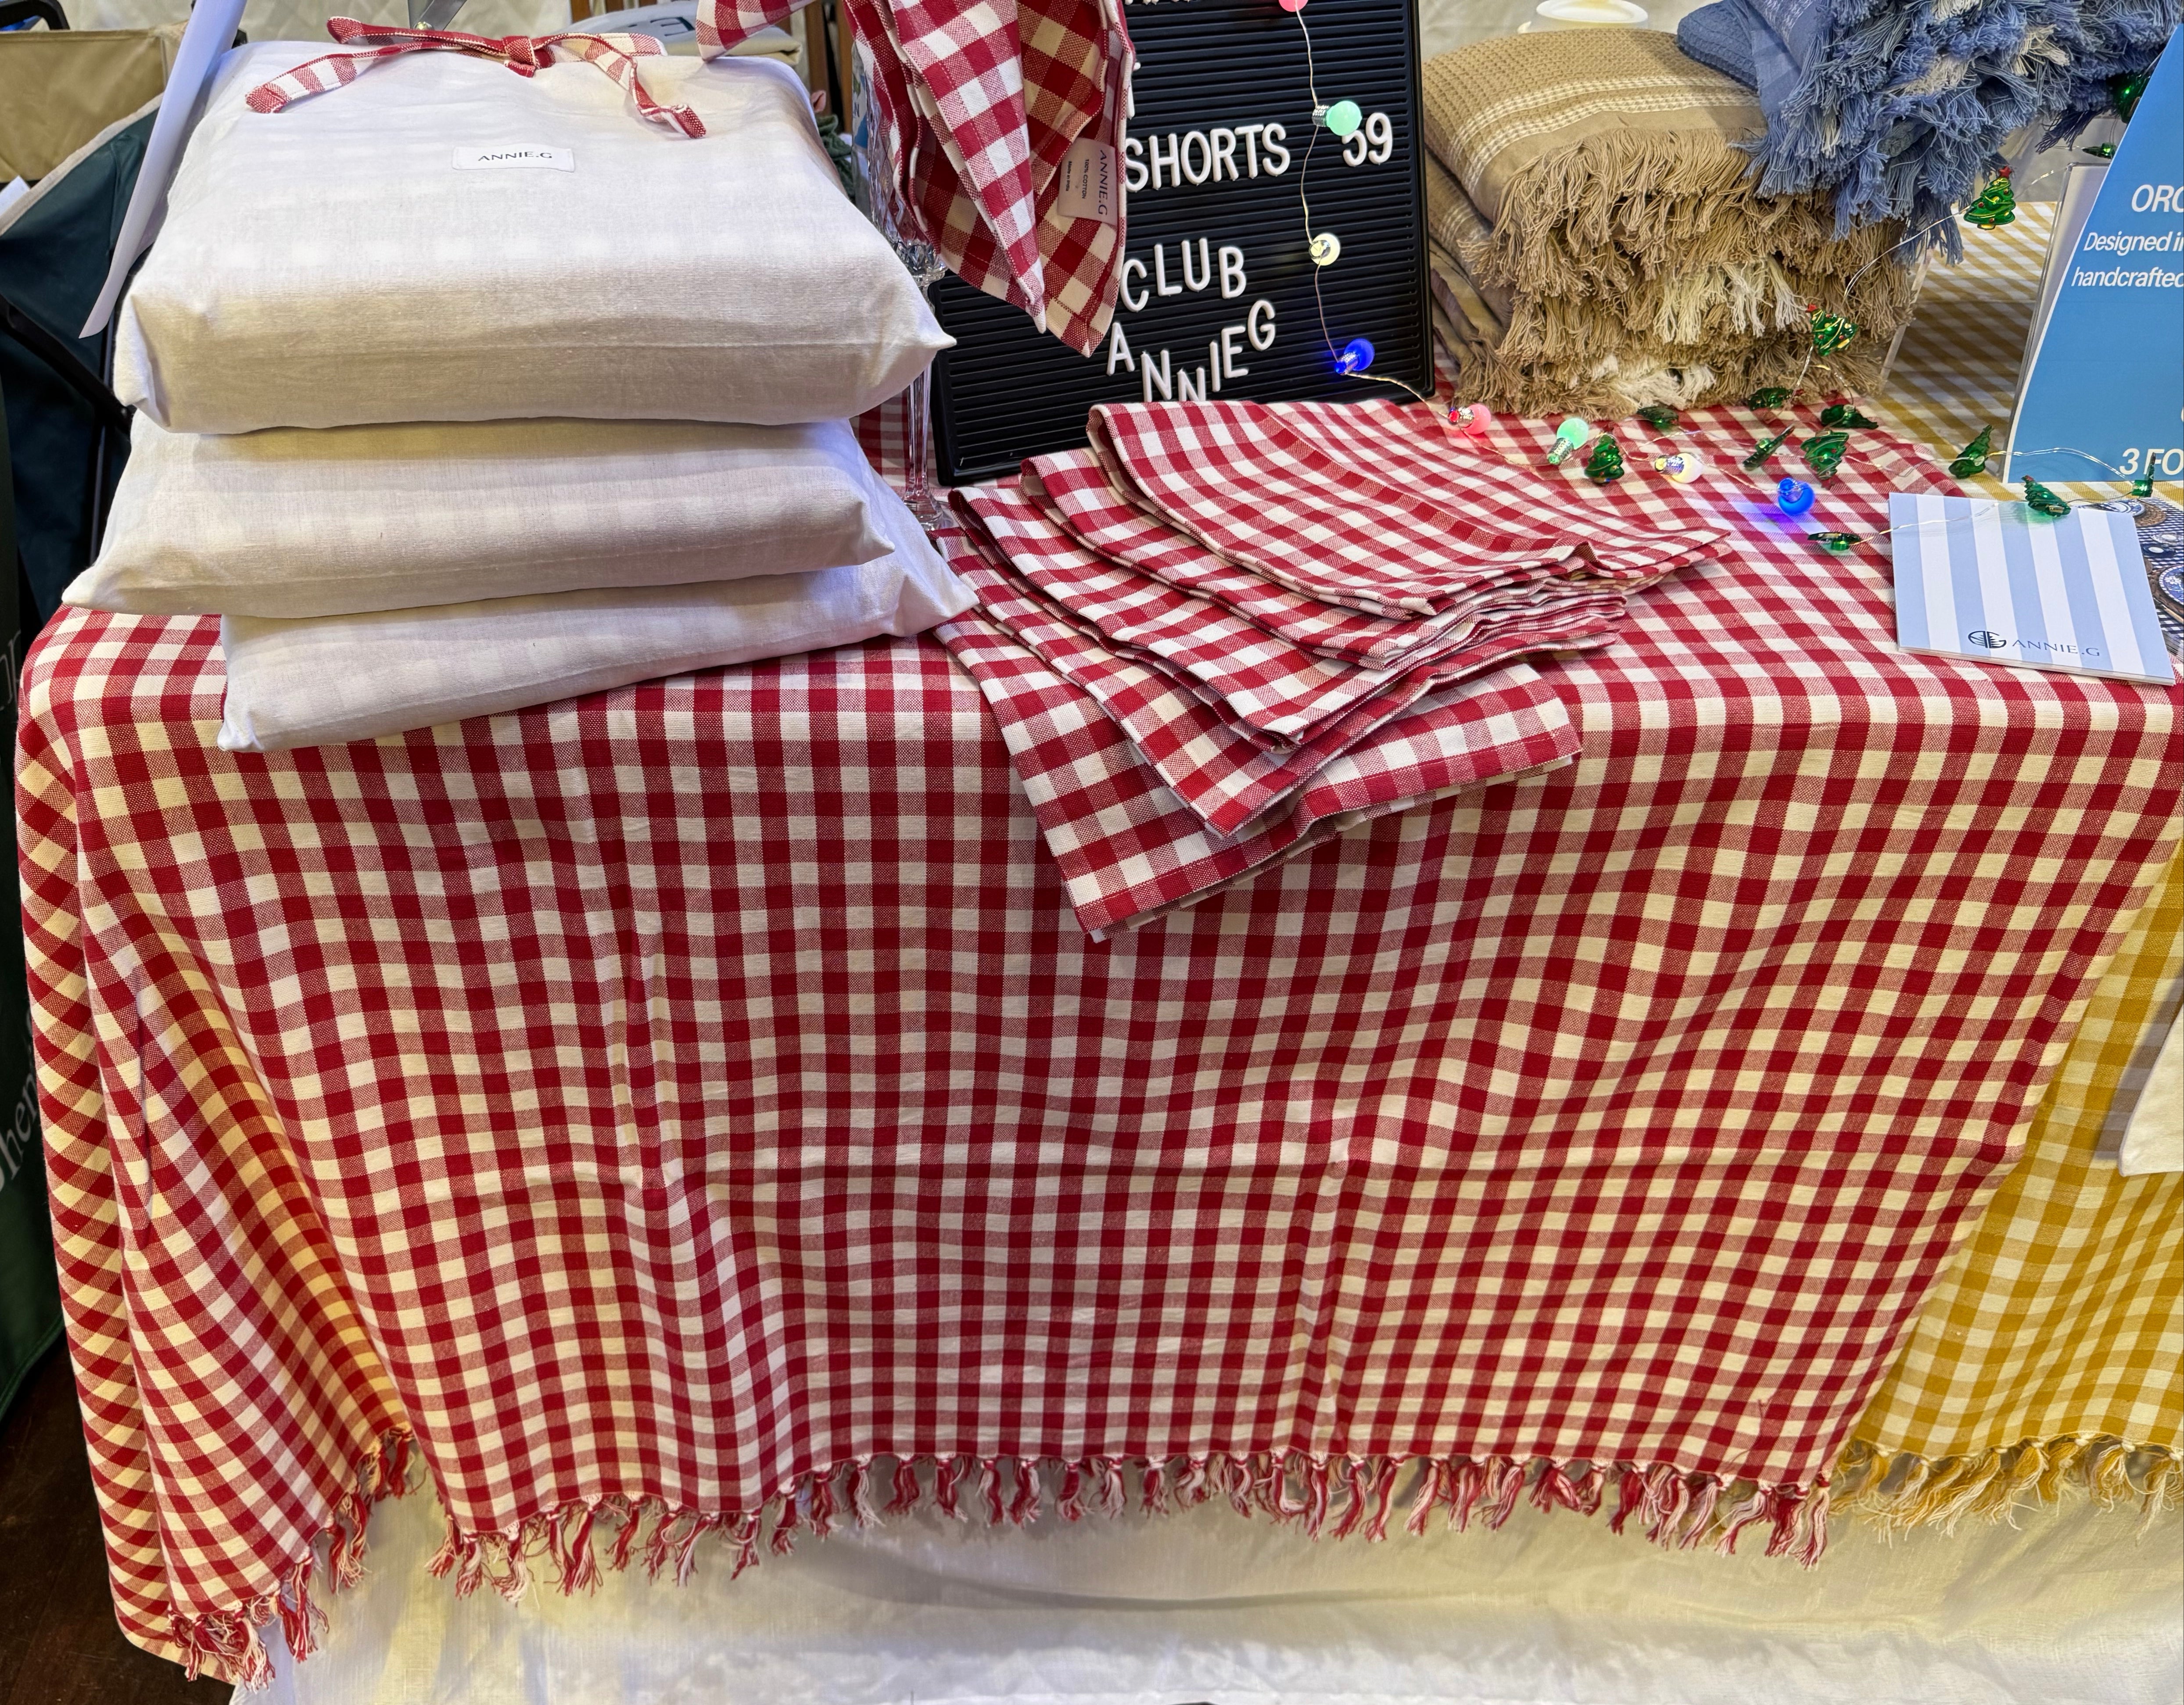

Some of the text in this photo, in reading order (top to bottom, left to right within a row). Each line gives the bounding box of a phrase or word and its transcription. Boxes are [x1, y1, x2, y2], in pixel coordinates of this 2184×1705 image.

[478, 151, 552, 161] ANNIE.G
[1125, 123, 1291, 192] SHORTS
[1098, 150, 1108, 215] ANNIE.G
[2083, 231, 2173, 256] Designed
[1120, 237, 1247, 312] CLUB
[2119, 448, 2140, 475] 3
[2012, 639, 2100, 656] ANNIE.G
